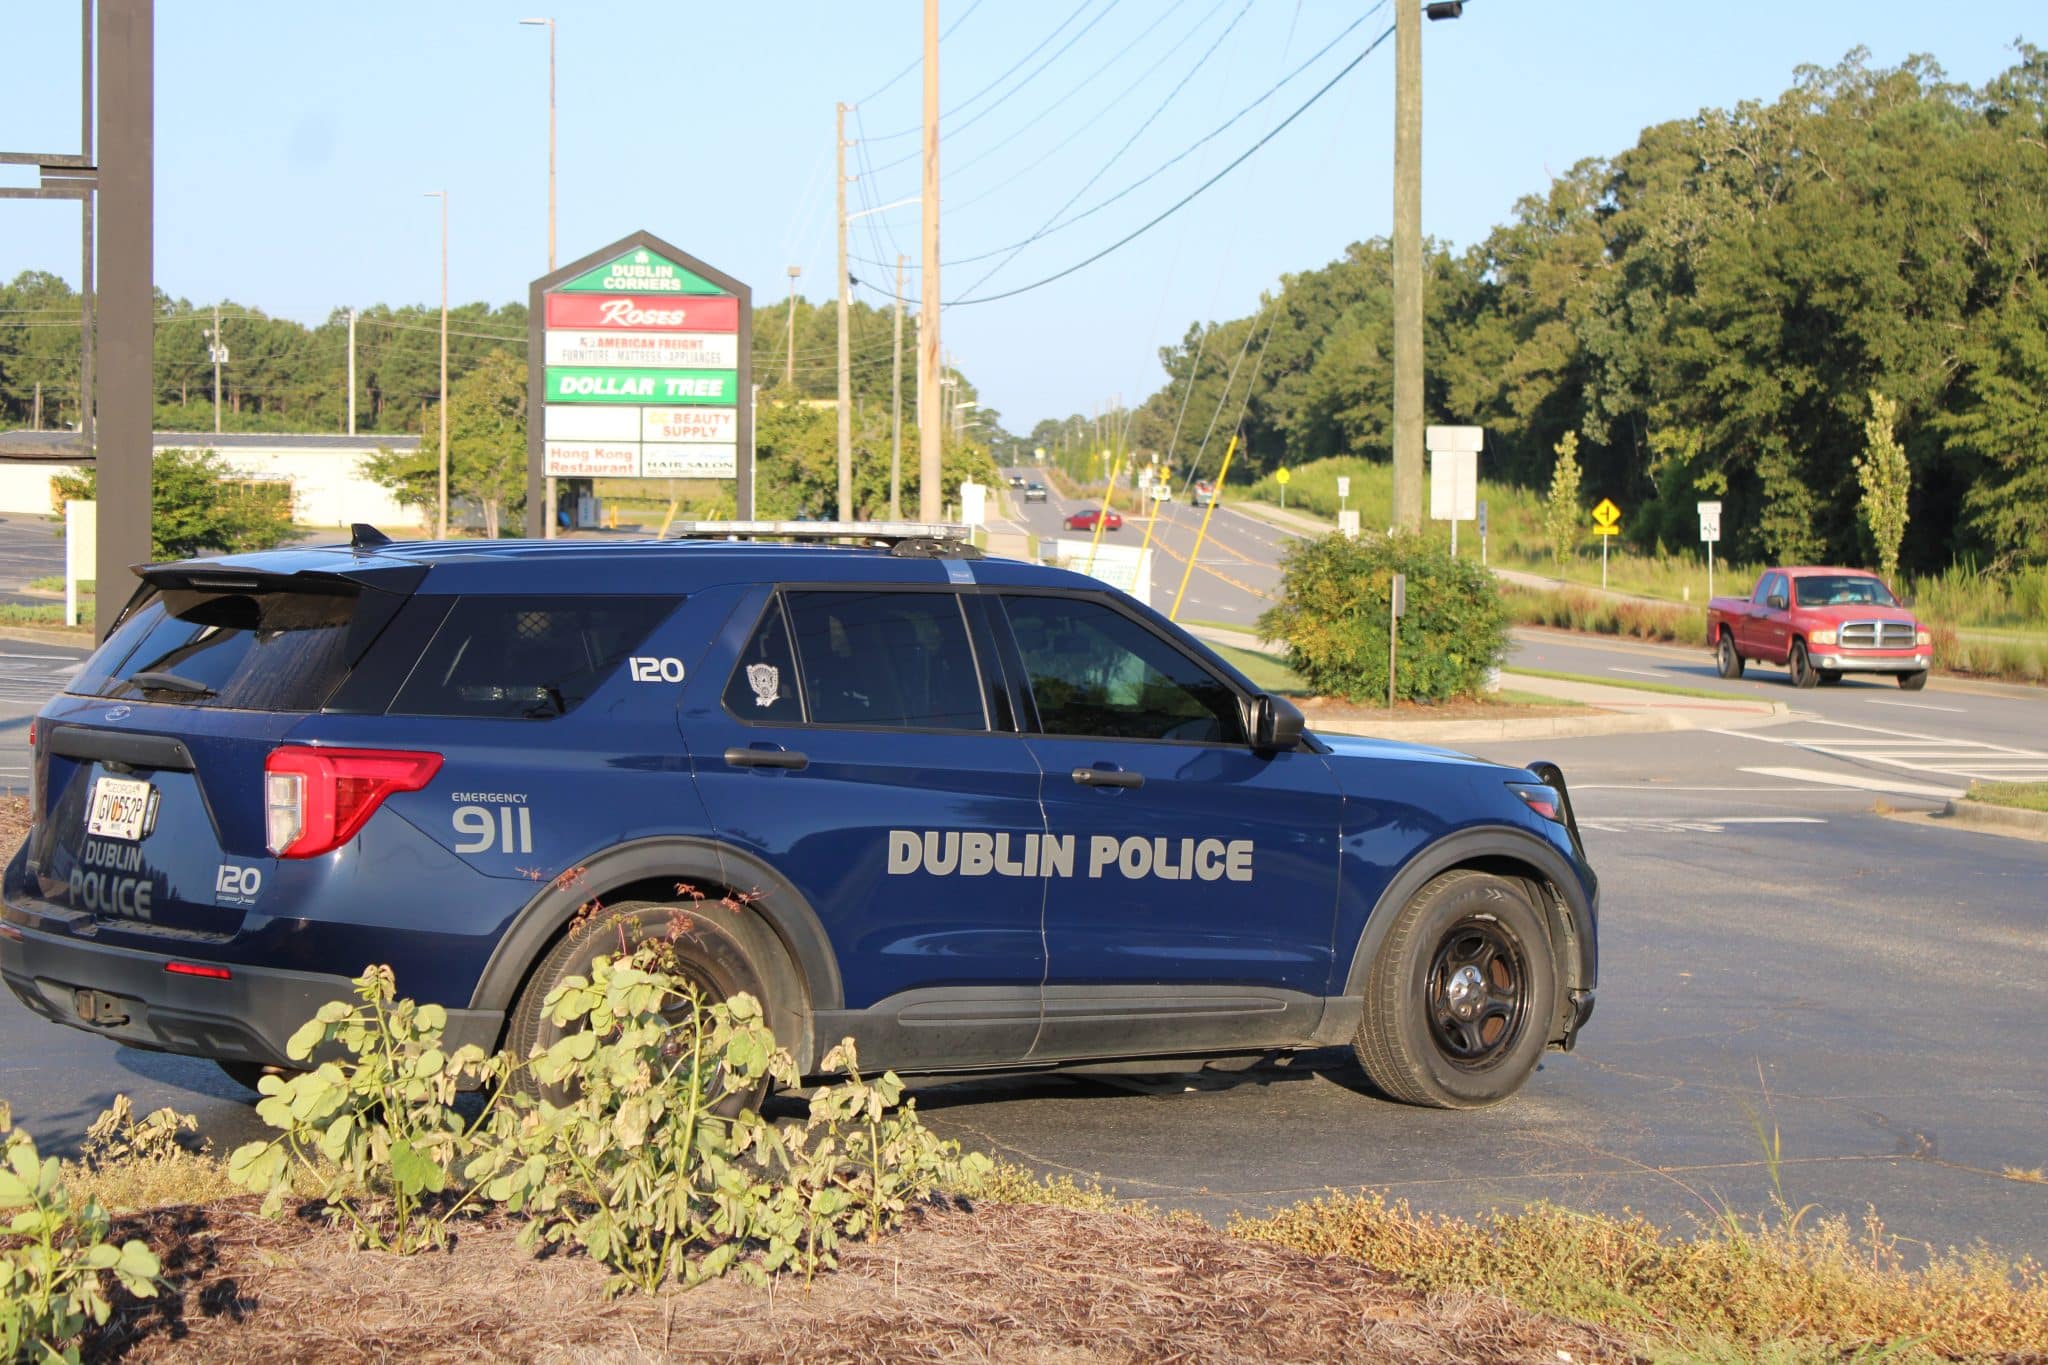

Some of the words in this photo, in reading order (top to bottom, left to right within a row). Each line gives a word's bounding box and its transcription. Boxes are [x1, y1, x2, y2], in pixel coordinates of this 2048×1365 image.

[612, 265, 673, 278] DUBLIN
[603, 277, 682, 291] CORNERS
[597, 337, 655, 349] AMERICAN
[658, 339, 704, 350] FREIGHT
[562, 349, 609, 362] FURNITURE
[617, 350, 663, 363] MATTRESS
[669, 352, 721, 365] APPLIANCES
[560, 376, 655, 395] DOLLAR
[665, 379, 724, 397] TREE
[673, 413, 731, 426] BEAUTY
[663, 426, 718, 438] SUPPLY
[550, 447, 589, 461] Hong
[595, 447, 633, 461] Kong
[550, 461, 635, 473] Restaurant
[628, 656, 686, 683] 120
[451, 792, 528, 804] EMERGENCY
[99, 794, 143, 825] GV0552P
[452, 805, 532, 855] 911
[85, 842, 142, 872] DUBLIN
[887, 830, 1075, 878] DUBLIN
[1088, 835, 1254, 882] POLICE
[215, 864, 262, 896] 120
[71, 869, 152, 919] POLICE
